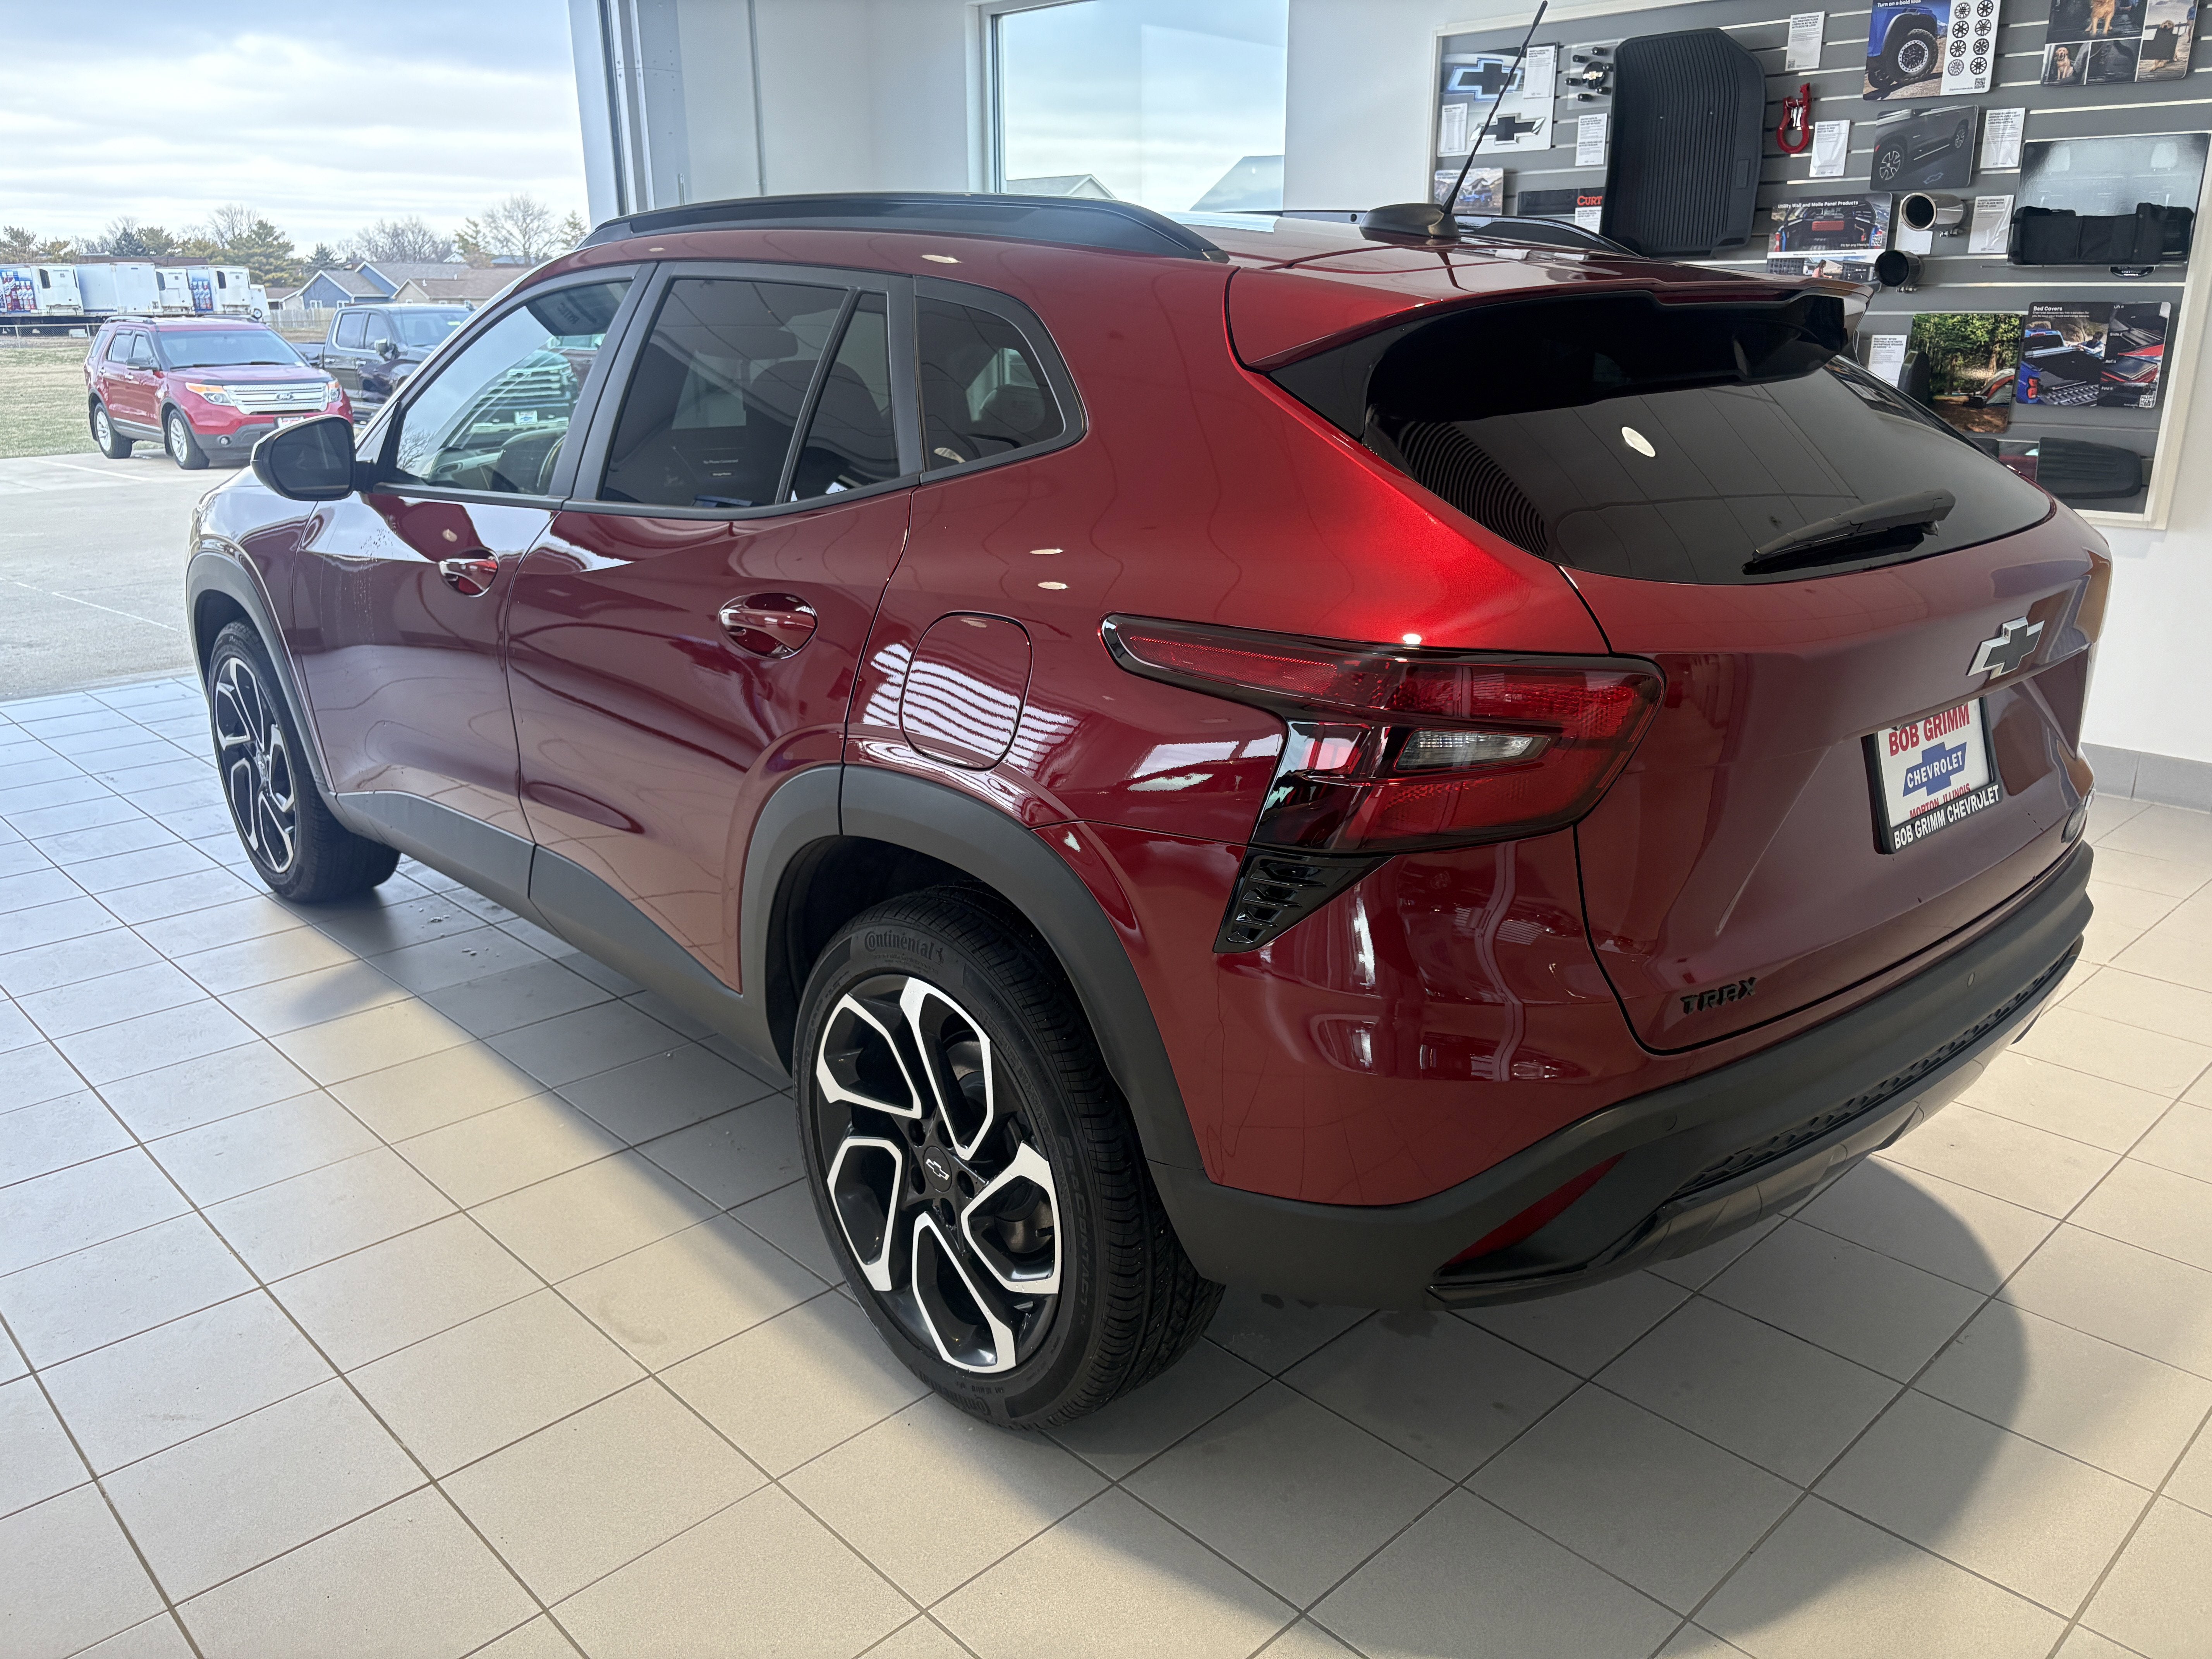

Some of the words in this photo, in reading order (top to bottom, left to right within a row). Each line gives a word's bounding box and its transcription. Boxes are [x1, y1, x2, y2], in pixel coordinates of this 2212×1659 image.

[1577, 196, 1602, 206] CURT
[1889, 724, 1920, 756] BOB
[1923, 702, 1970, 742] GRIMM
[1907, 750, 1963, 788] CHEVROLET
[1894, 824, 1914, 849] BOB
[1915, 812, 1946, 839] GRIMM
[1947, 784, 1999, 823] CHEVROLET
[864, 929, 934, 961] Continental
[1680, 977, 1757, 1014] TRAX
